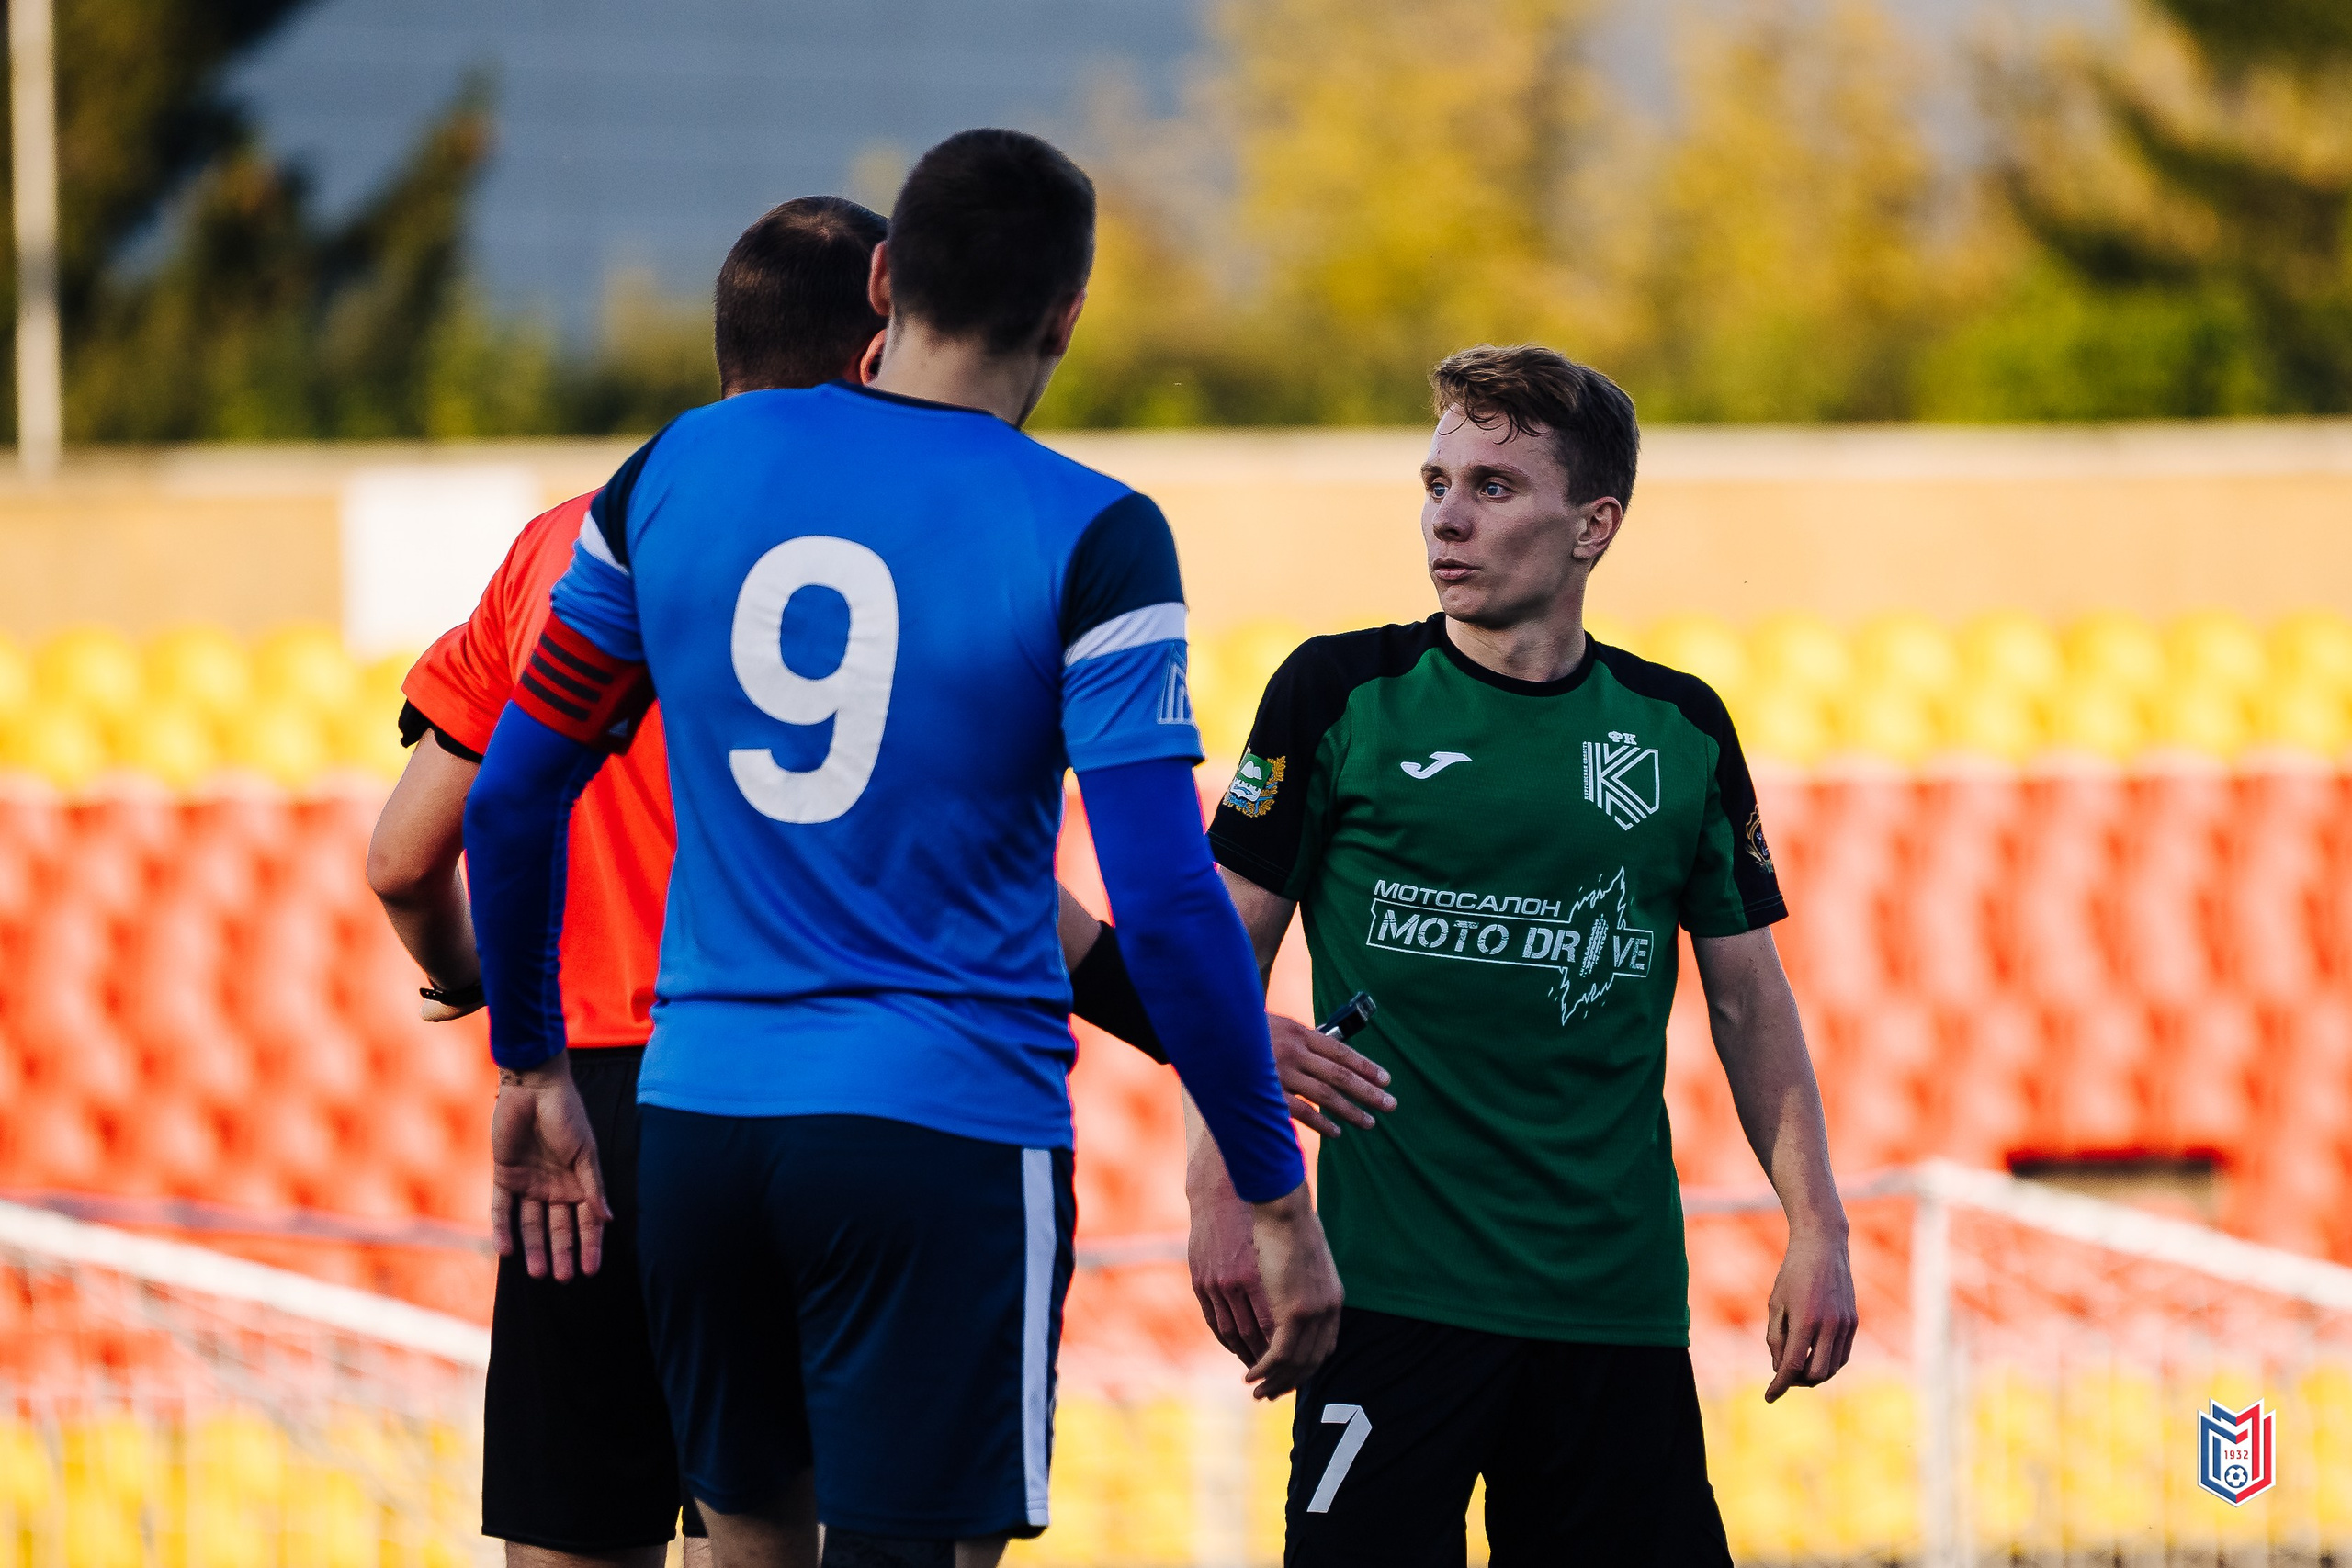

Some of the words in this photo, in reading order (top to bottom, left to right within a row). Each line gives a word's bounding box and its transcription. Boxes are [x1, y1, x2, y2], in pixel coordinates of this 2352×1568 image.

[729, 534, 899, 824] 9
[1607, 730, 1638, 745] ФК
[1374, 879, 1562, 917] МОТОСАЛОН
[1377, 909, 1510, 955] MOTO
[1306, 1404, 1373, 1513] 7
